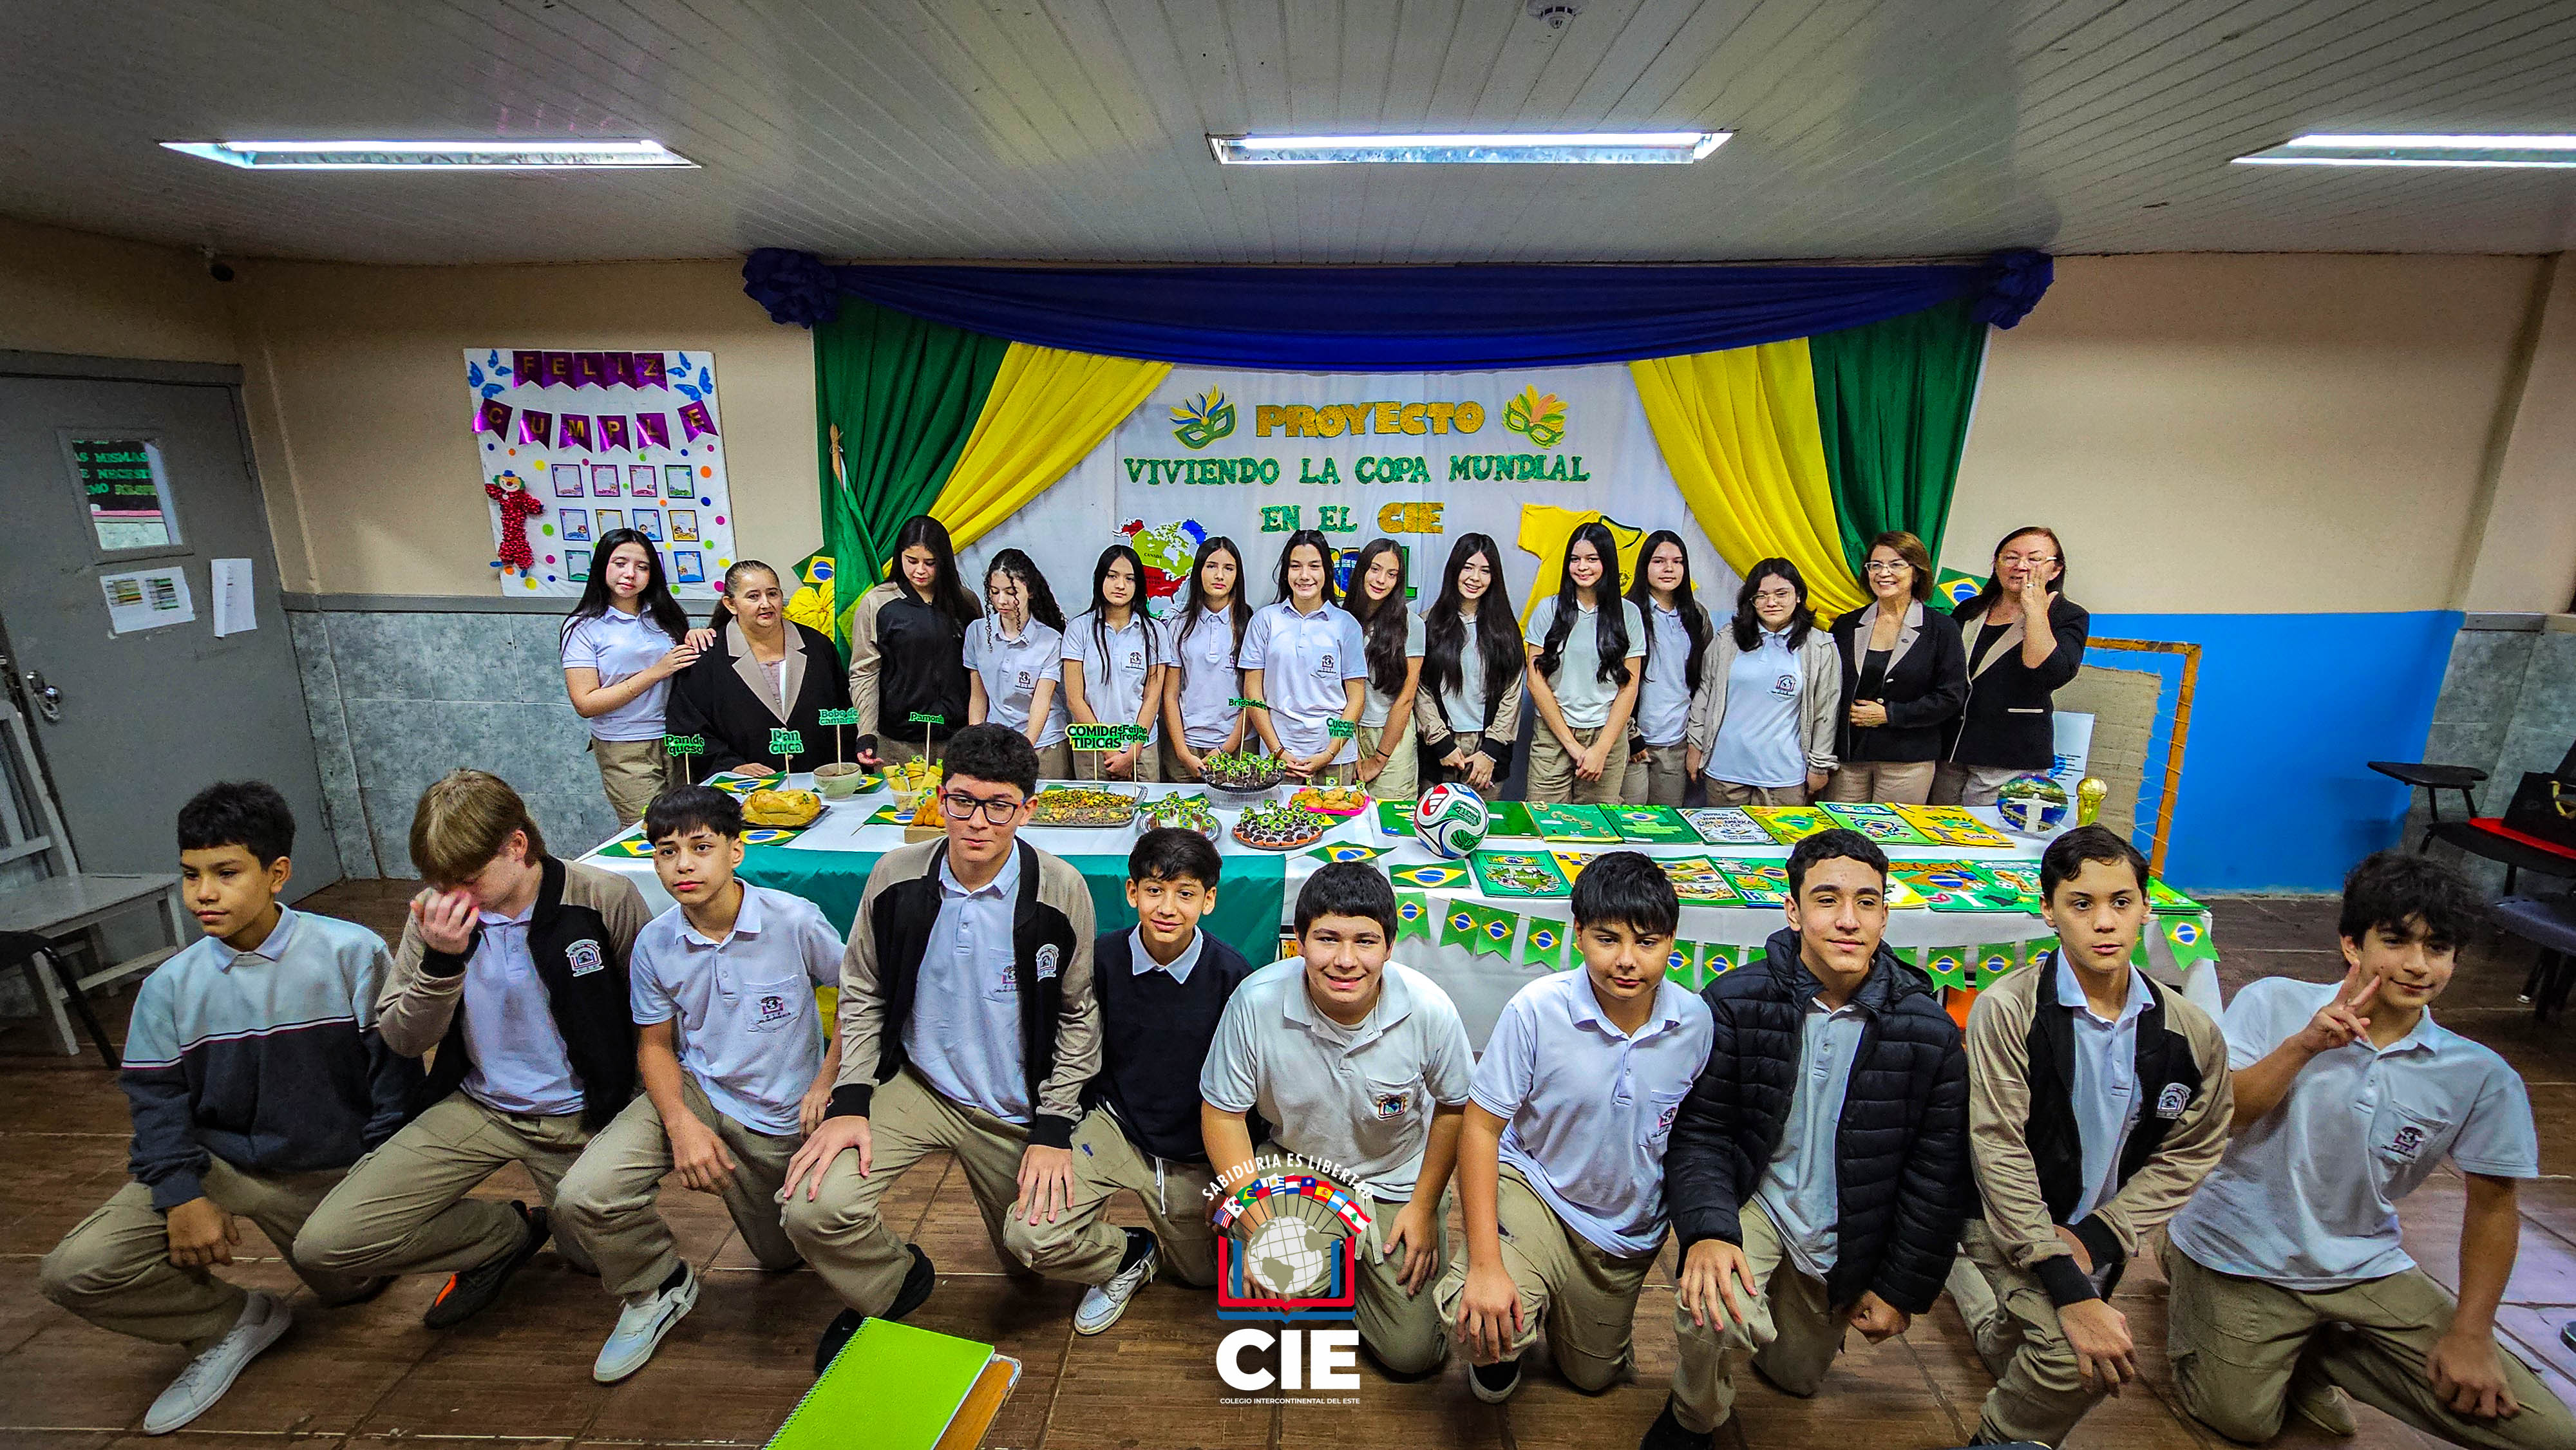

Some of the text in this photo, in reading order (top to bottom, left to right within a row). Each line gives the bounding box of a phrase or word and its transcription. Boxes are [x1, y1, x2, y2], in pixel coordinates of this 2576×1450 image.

[524, 356, 658, 377] FELIZ
[488, 407, 705, 439] CUMPLE
[1256, 400, 1486, 437] PROYECTO
[1124, 454, 1591, 486] VIVIENDO LA COPA MUNDIAL
[1260, 501, 1445, 535] EN EL CIE
[822, 710, 846, 718] Bobo
[665, 734, 705, 746] Pan de
[773, 730, 799, 741] Pan
[1072, 737, 1122, 749] TIPICAS
[668, 744, 703, 756] queso
